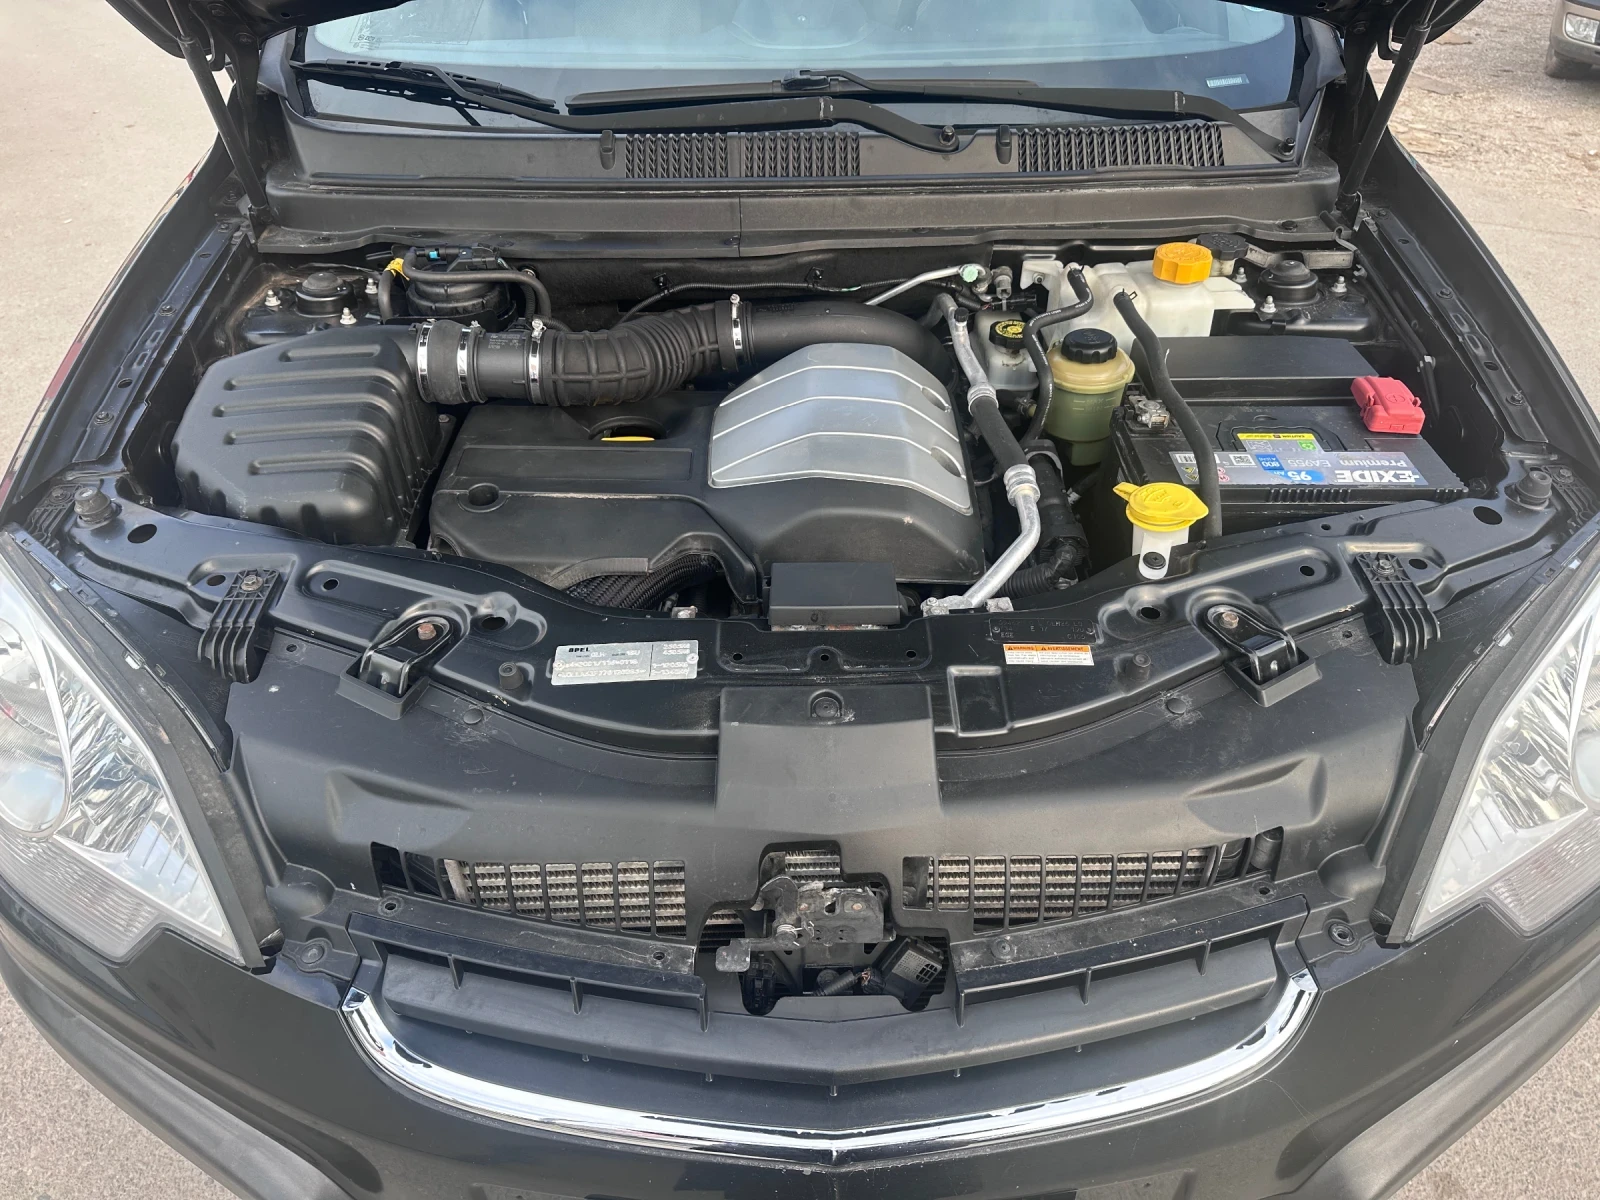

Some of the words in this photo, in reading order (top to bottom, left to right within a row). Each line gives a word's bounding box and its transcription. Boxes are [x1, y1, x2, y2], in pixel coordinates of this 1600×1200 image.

[1288, 459, 1332, 468] EA955
[1339, 458, 1407, 467] Premium
[1287, 471, 1312, 481] 95
[1335, 469, 1420, 483] EXIDE
